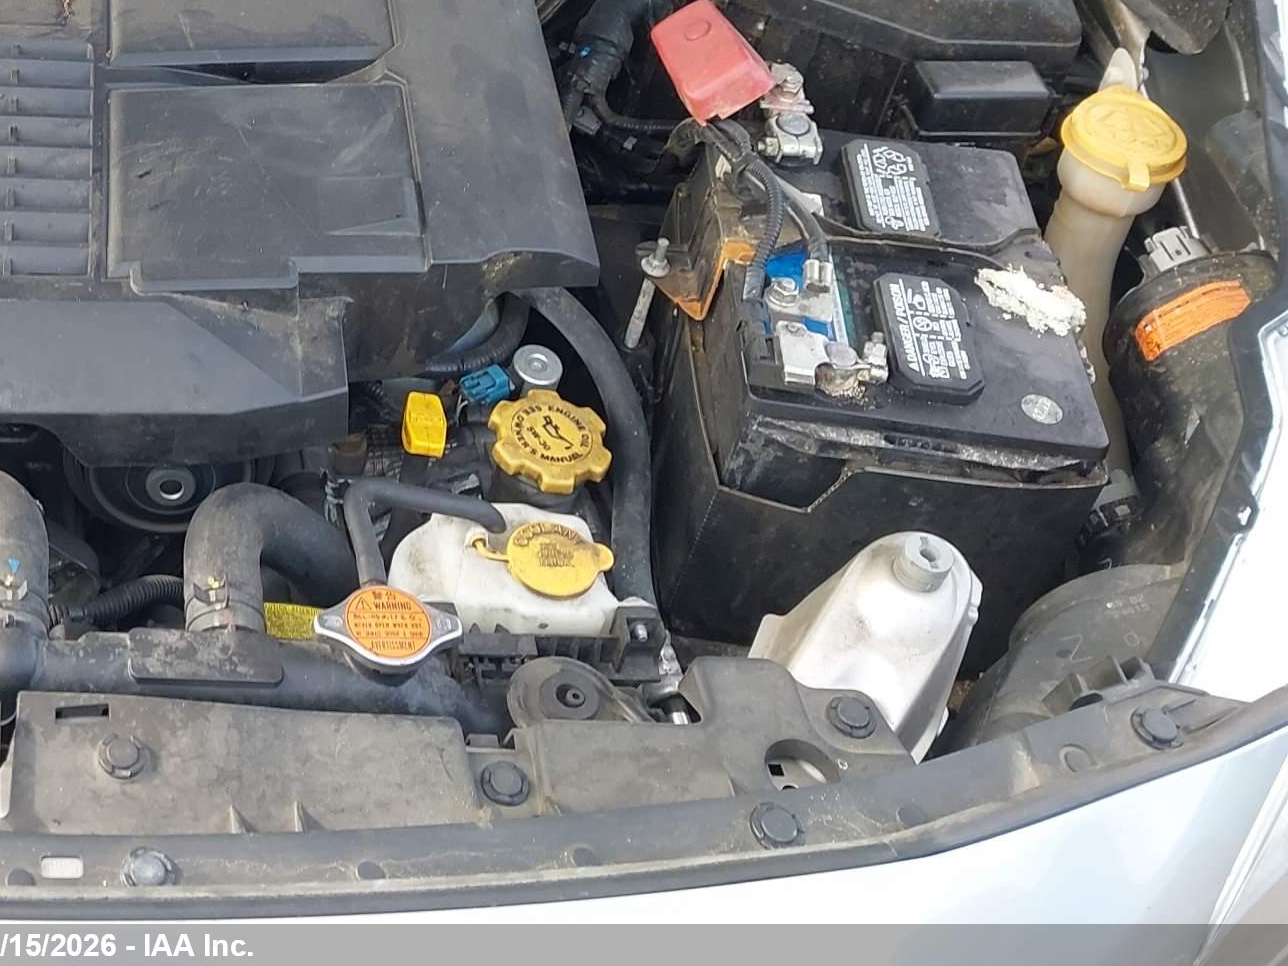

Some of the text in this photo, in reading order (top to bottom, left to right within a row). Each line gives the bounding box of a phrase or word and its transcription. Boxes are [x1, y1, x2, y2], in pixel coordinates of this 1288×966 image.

[522, 404, 542, 416] SEE
[540, 451, 583, 463] MANUAL
[548, 405, 590, 448] ENGINE OIL
[513, 521, 587, 547] COOLANT
[373, 601, 412, 611] WARNING
